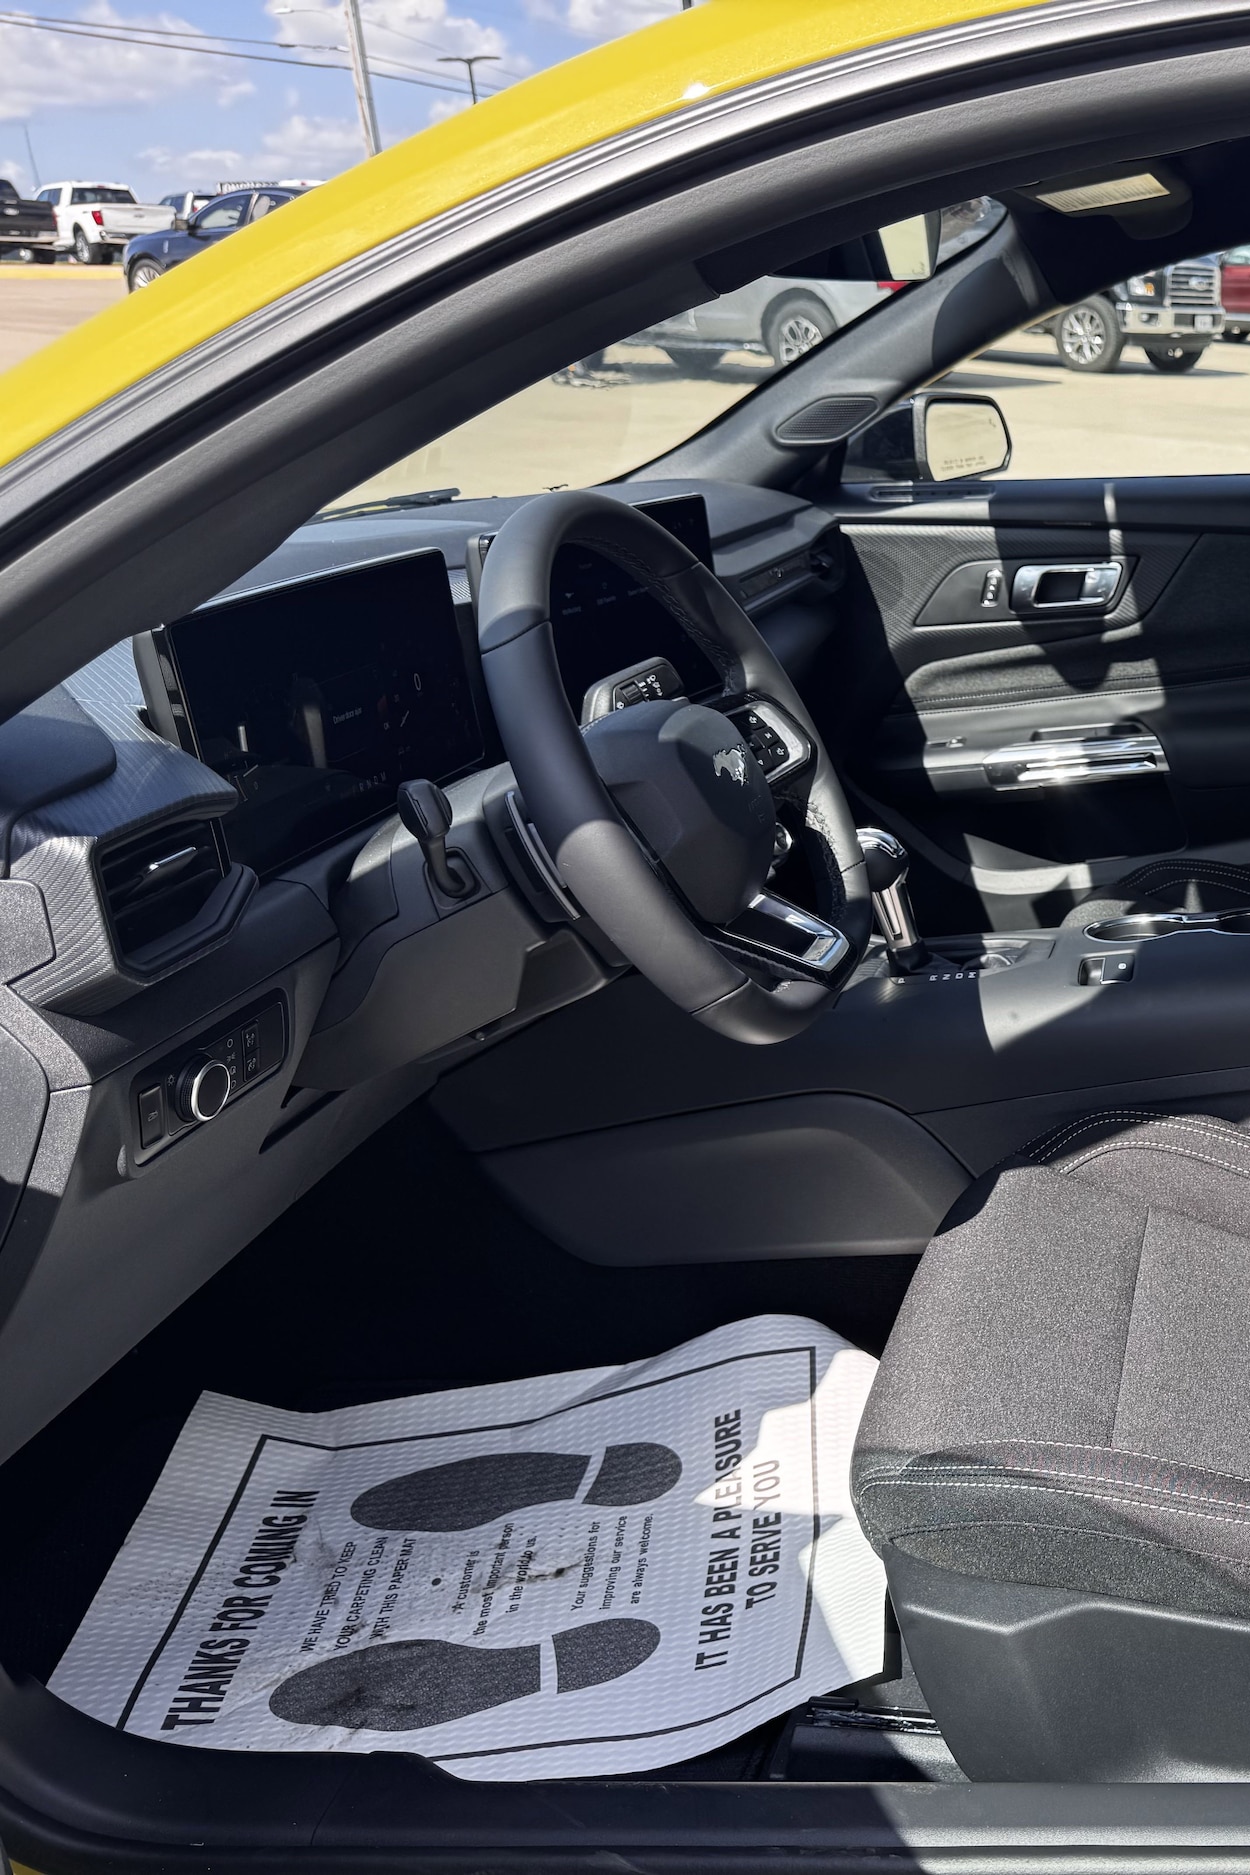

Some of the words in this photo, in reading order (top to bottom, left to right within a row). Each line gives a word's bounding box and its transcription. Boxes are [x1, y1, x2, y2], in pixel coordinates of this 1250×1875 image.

[413, 673, 422, 691] 0
[712, 1408, 742, 1522] PLEASURE
[752, 1460, 780, 1510] YOU
[270, 1490, 320, 1508] IN
[497, 1523, 514, 1550] person
[588, 1522, 600, 1534] for
[614, 1516, 628, 1547] service
[638, 1514, 653, 1555] welcome.
[710, 1526, 741, 1539] A
[233, 1515, 308, 1588] COMING
[338, 1542, 357, 1563] KEEP
[399, 1538, 416, 1556] MAT
[520, 1550, 533, 1558] to
[526, 1536, 537, 1548] us.
[748, 1512, 782, 1576] SERVE
[580, 1536, 598, 1588] suggestions
[611, 1550, 621, 1563] our
[332, 1567, 347, 1579] TO
[388, 1558, 410, 1590] PAPER
[457, 1559, 475, 1600] customer
[482, 1552, 506, 1590] important
[515, 1559, 530, 1583] world
[632, 1558, 648, 1587] always
[704, 1547, 740, 1597] BEEN
[320, 1582, 341, 1607] TRIED
[334, 1625, 357, 1650] YOUR
[346, 1569, 376, 1622] CARPETING
[368, 1536, 388, 1566] CLEAN
[510, 1586, 523, 1600] the
[570, 1590, 585, 1610] Your
[600, 1566, 621, 1610] improving
[630, 1591, 641, 1604] are
[745, 1582, 778, 1610] TO
[209, 1595, 273, 1632] FOR
[379, 1594, 398, 1614] THIS
[452, 1602, 464, 1610] A
[480, 1592, 494, 1617] most
[506, 1604, 519, 1613] in
[308, 1610, 330, 1634] HAVE
[369, 1617, 390, 1639] WITH
[472, 1620, 487, 1635] the
[698, 1602, 734, 1644] HAS
[300, 1637, 318, 1652] WE
[695, 1651, 728, 1670] IT
[161, 1638, 250, 1730] THANKS
